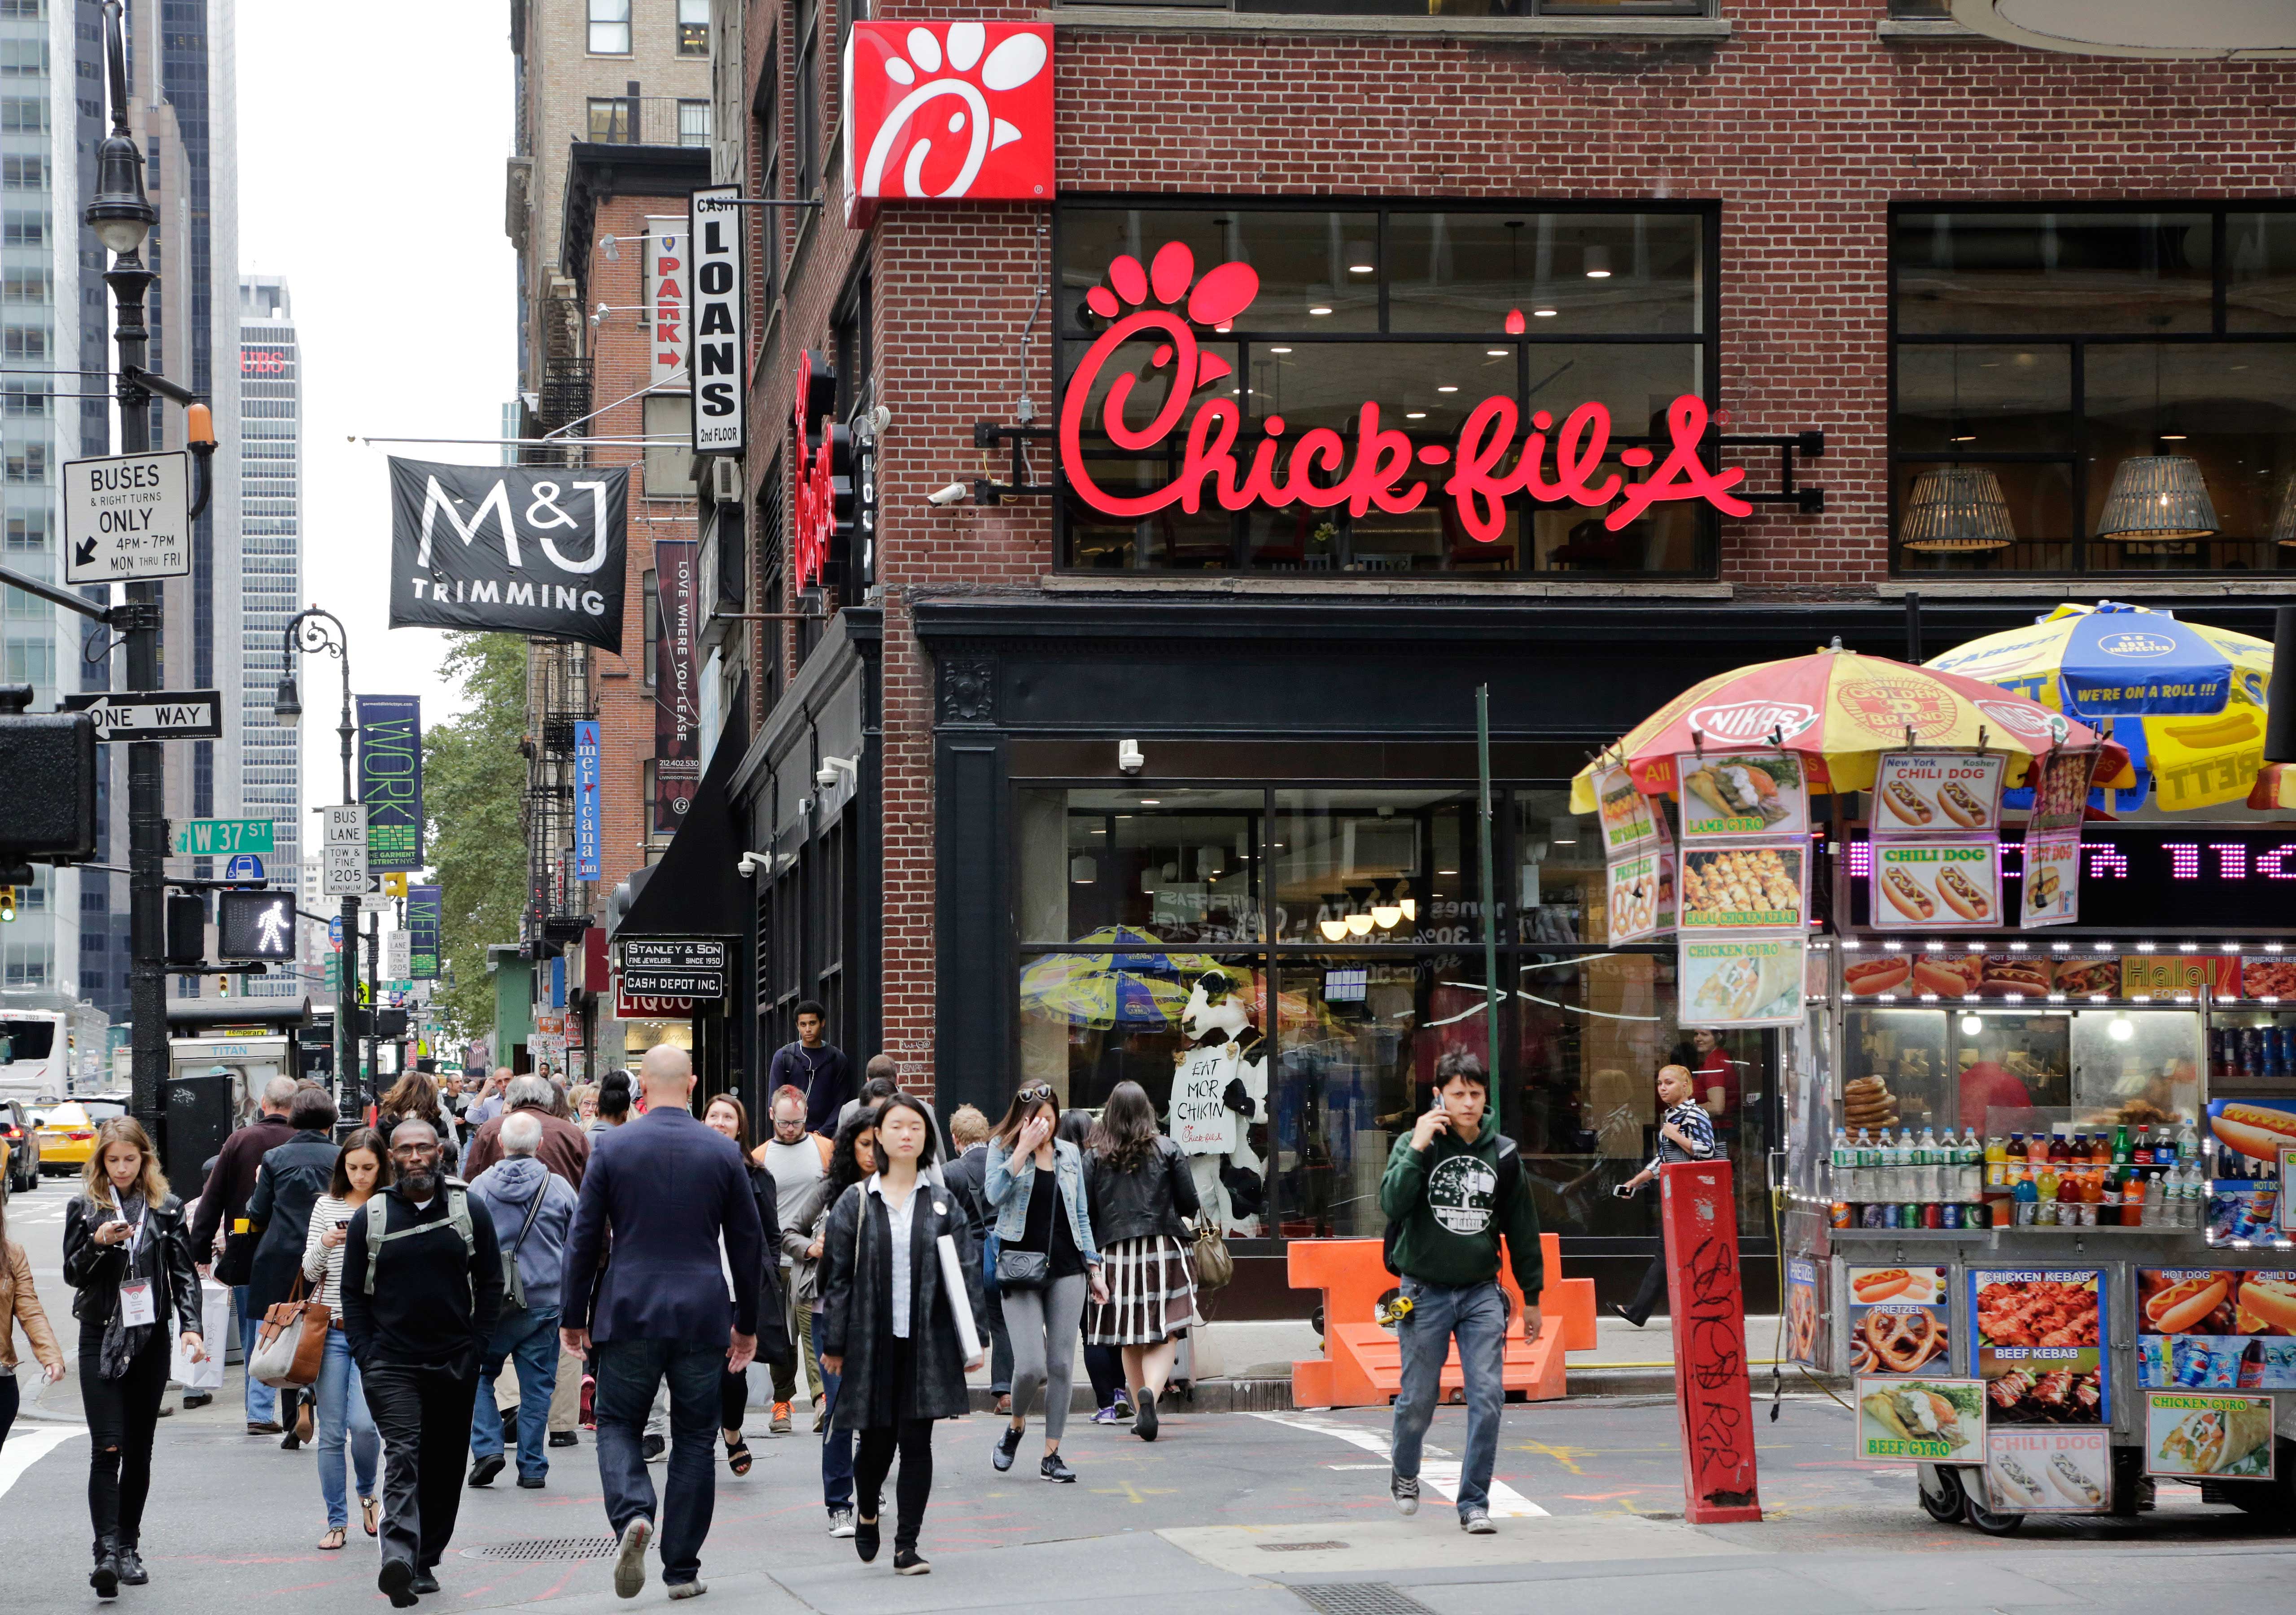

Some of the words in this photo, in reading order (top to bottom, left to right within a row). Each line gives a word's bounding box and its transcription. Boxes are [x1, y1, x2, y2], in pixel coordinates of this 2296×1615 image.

[656, 257, 682, 343] PARK
[699, 221, 735, 416] LOANS
[241, 351, 284, 373] UBS
[700, 429, 712, 442] 2nd
[714, 427, 737, 441] FLOOR
[1059, 310, 1754, 542] Chick-fil-A
[91, 464, 159, 491] BUSES
[91, 498, 97, 506] &
[101, 495, 127, 506] RIGHT
[131, 492, 162, 503] TURNS
[100, 507, 153, 533] ONLY
[417, 475, 607, 574] M&J
[116, 537, 140, 550] 4PM
[151, 535, 174, 548] 7PM
[111, 556, 133, 571] MON
[140, 557, 158, 567] THRU
[164, 552, 180, 566] FRI
[679, 561, 688, 598] LOVE
[412, 578, 605, 616] TRIMMING
[678, 603, 688, 655] WHERE
[677, 661, 687, 690] YOU
[1848, 687, 1940, 699] GOLDEN
[2077, 688, 2121, 702] WE'RE
[2125, 685, 2145, 699] ON
[2148, 685, 2158, 697] A
[2163, 684, 2196, 698] ROLL
[91, 708, 133, 728] ONE
[155, 707, 201, 725] WAY
[677, 696, 687, 741] LEASE
[1707, 706, 1799, 736] NIKAS
[1869, 711, 1946, 725] BRAND
[364, 718, 415, 820] WORK
[1887, 759, 1910, 767] New
[1913, 758, 1936, 767] York
[1644, 762, 1671, 783] All
[1897, 768, 1942, 779] CHILI
[1949, 768, 1985, 779] DOG
[334, 811, 356, 823] BUS
[1688, 819, 1724, 834] LAMB
[1726, 817, 1764, 832] GYRO
[194, 824, 212, 851] W
[219, 823, 244, 851] 37
[248, 822, 267, 837] ST
[331, 828, 360, 840] LANE
[354, 848, 360, 857] &
[1884, 849, 1939, 862] CHILI
[1943, 849, 1986, 862] DOG
[336, 858, 355, 867] FINE
[578, 859, 597, 876] Inn
[330, 870, 361, 882] $205
[1686, 911, 1717, 925] HALAL
[1719, 911, 1763, 925] CHICKEN
[1764, 910, 1797, 924] KEBAB
[409, 902, 436, 952] MEET
[629, 943, 682, 954] STANLEY
[685, 946, 693, 954] &
[697, 944, 721, 954] SON
[1688, 945, 1742, 958] CHICKEN
[1746, 943, 1779, 956] GYRO
[2127, 958, 2217, 987] Halal
[628, 978, 656, 988] CASH
[660, 979, 695, 990] DEPOT
[698, 979, 718, 990] INC.
[2154, 989, 2191, 999] FOOD
[211, 1046, 247, 1055] TITAN
[1192, 1059, 1221, 1076] EAT
[1188, 1080, 1218, 1099] MOR
[1177, 1102, 1225, 1122] CHIKIN
[2253, 1182, 2267, 1190] HOT
[1791, 1262, 1814, 1283] PRETZEL
[1983, 1271, 2042, 1282] CHICKEN
[2044, 1271, 2090, 1282] KEBAB
[2162, 1270, 2184, 1279] HOT
[2186, 1270, 2211, 1279] DOG
[2258, 1271, 2286, 1280] CHILI
[1874, 1305, 1923, 1315] PRETZEL
[1995, 1348, 2029, 1359] BEEF
[2033, 1348, 2079, 1359] KEBAB
[2152, 1397, 2209, 1410] CHICKEN
[2210, 1398, 2247, 1411] GYRO
[1868, 1439, 1907, 1455] BEEF
[1908, 1440, 1951, 1457] GYRO
[1990, 1436, 2052, 1450] CHILI
[2056, 1436, 2102, 1450] DOG
